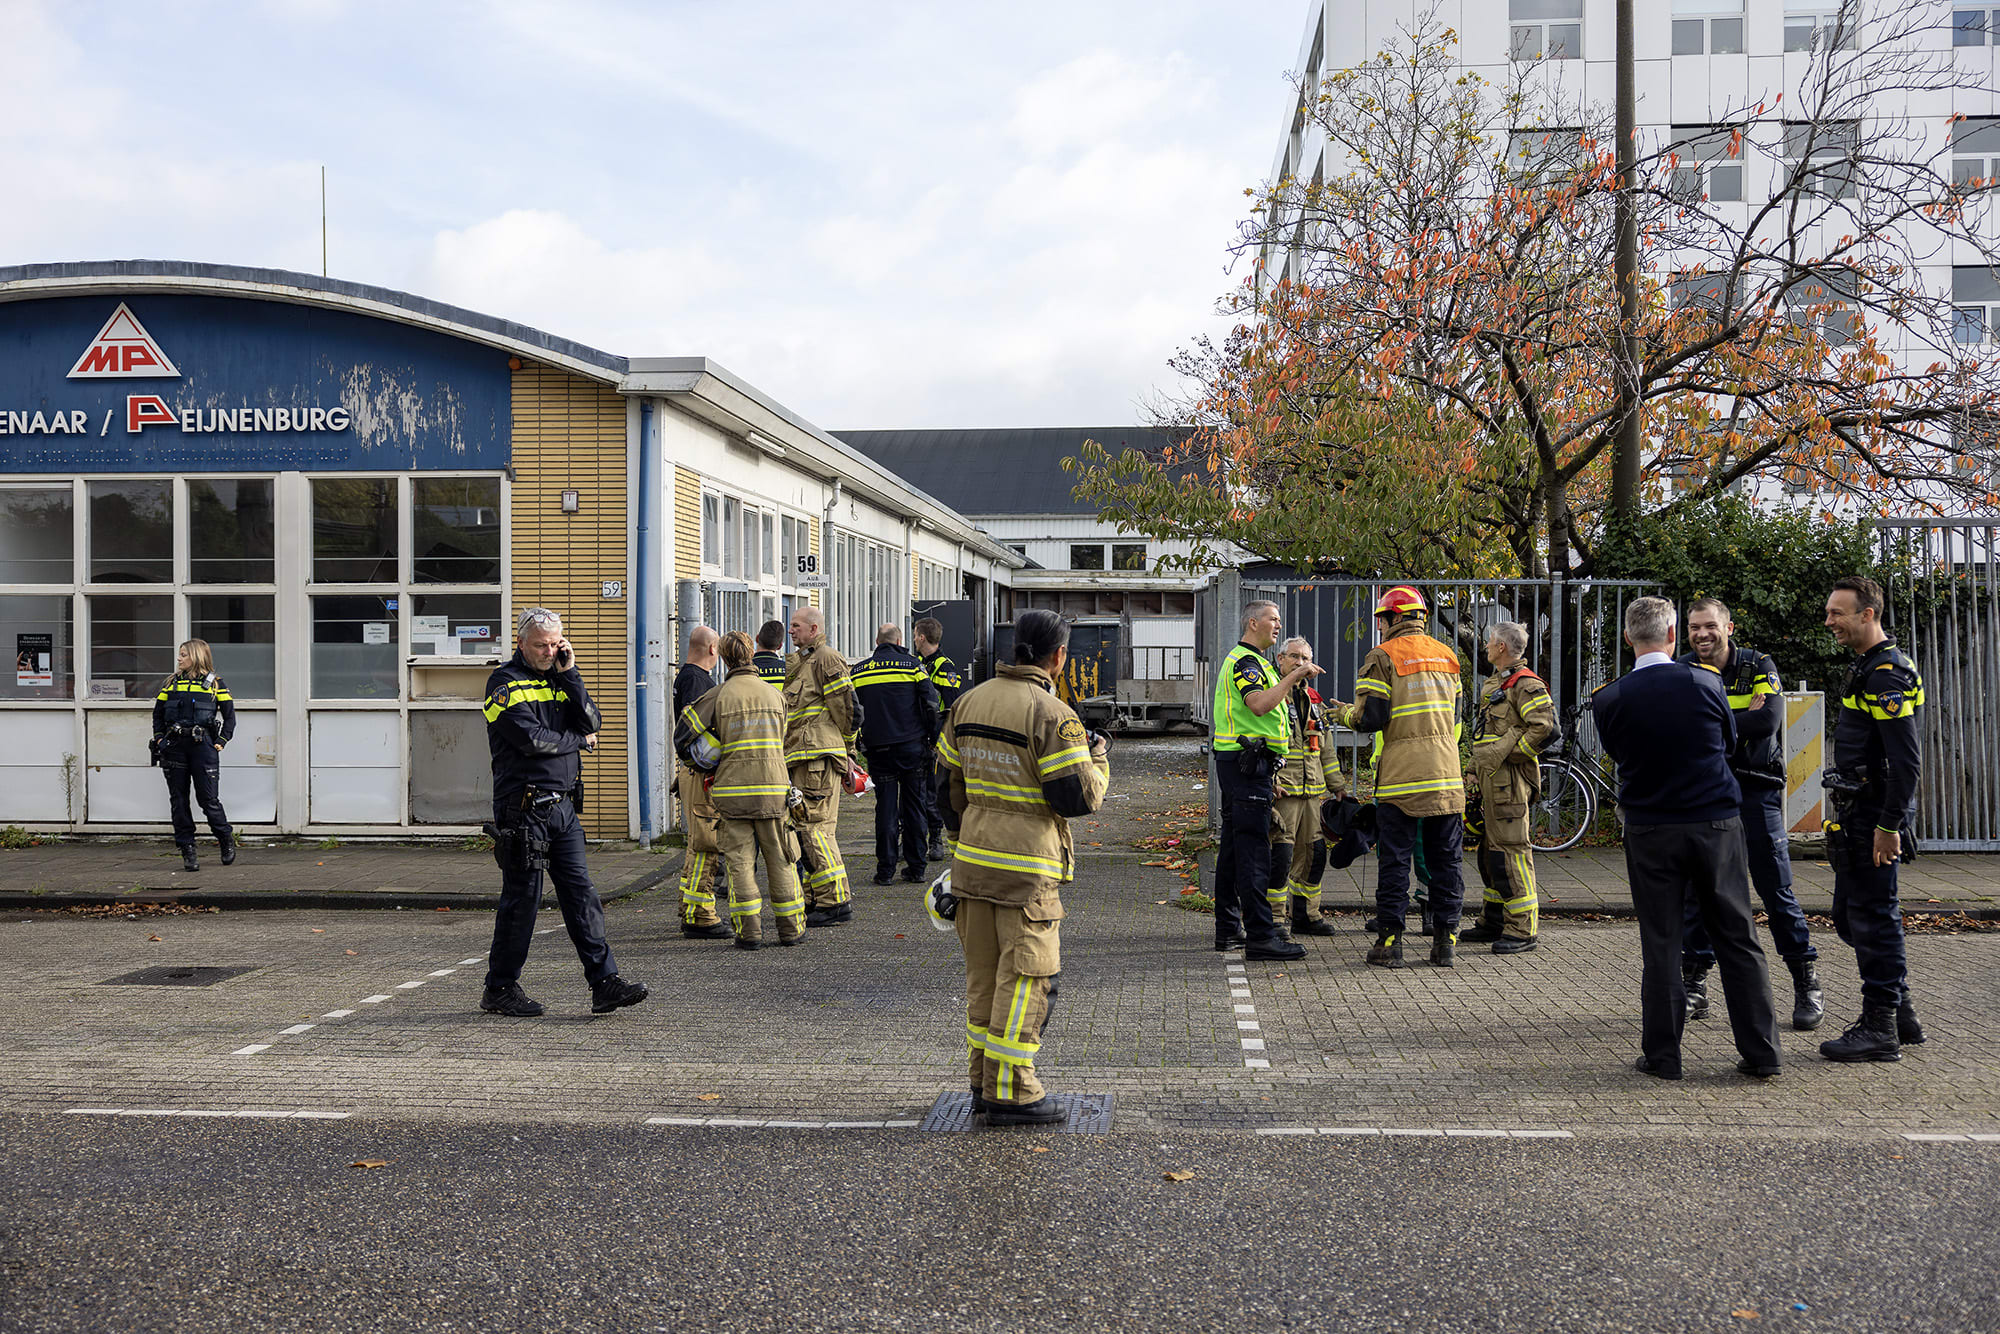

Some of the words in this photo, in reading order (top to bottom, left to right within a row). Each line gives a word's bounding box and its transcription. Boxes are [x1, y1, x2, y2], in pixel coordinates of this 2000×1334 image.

[127, 394, 350, 433] PEIJNENBURG
[798, 555, 816, 573] 59
[604, 582, 620, 596] 59
[759, 667, 783, 675] LITIE
